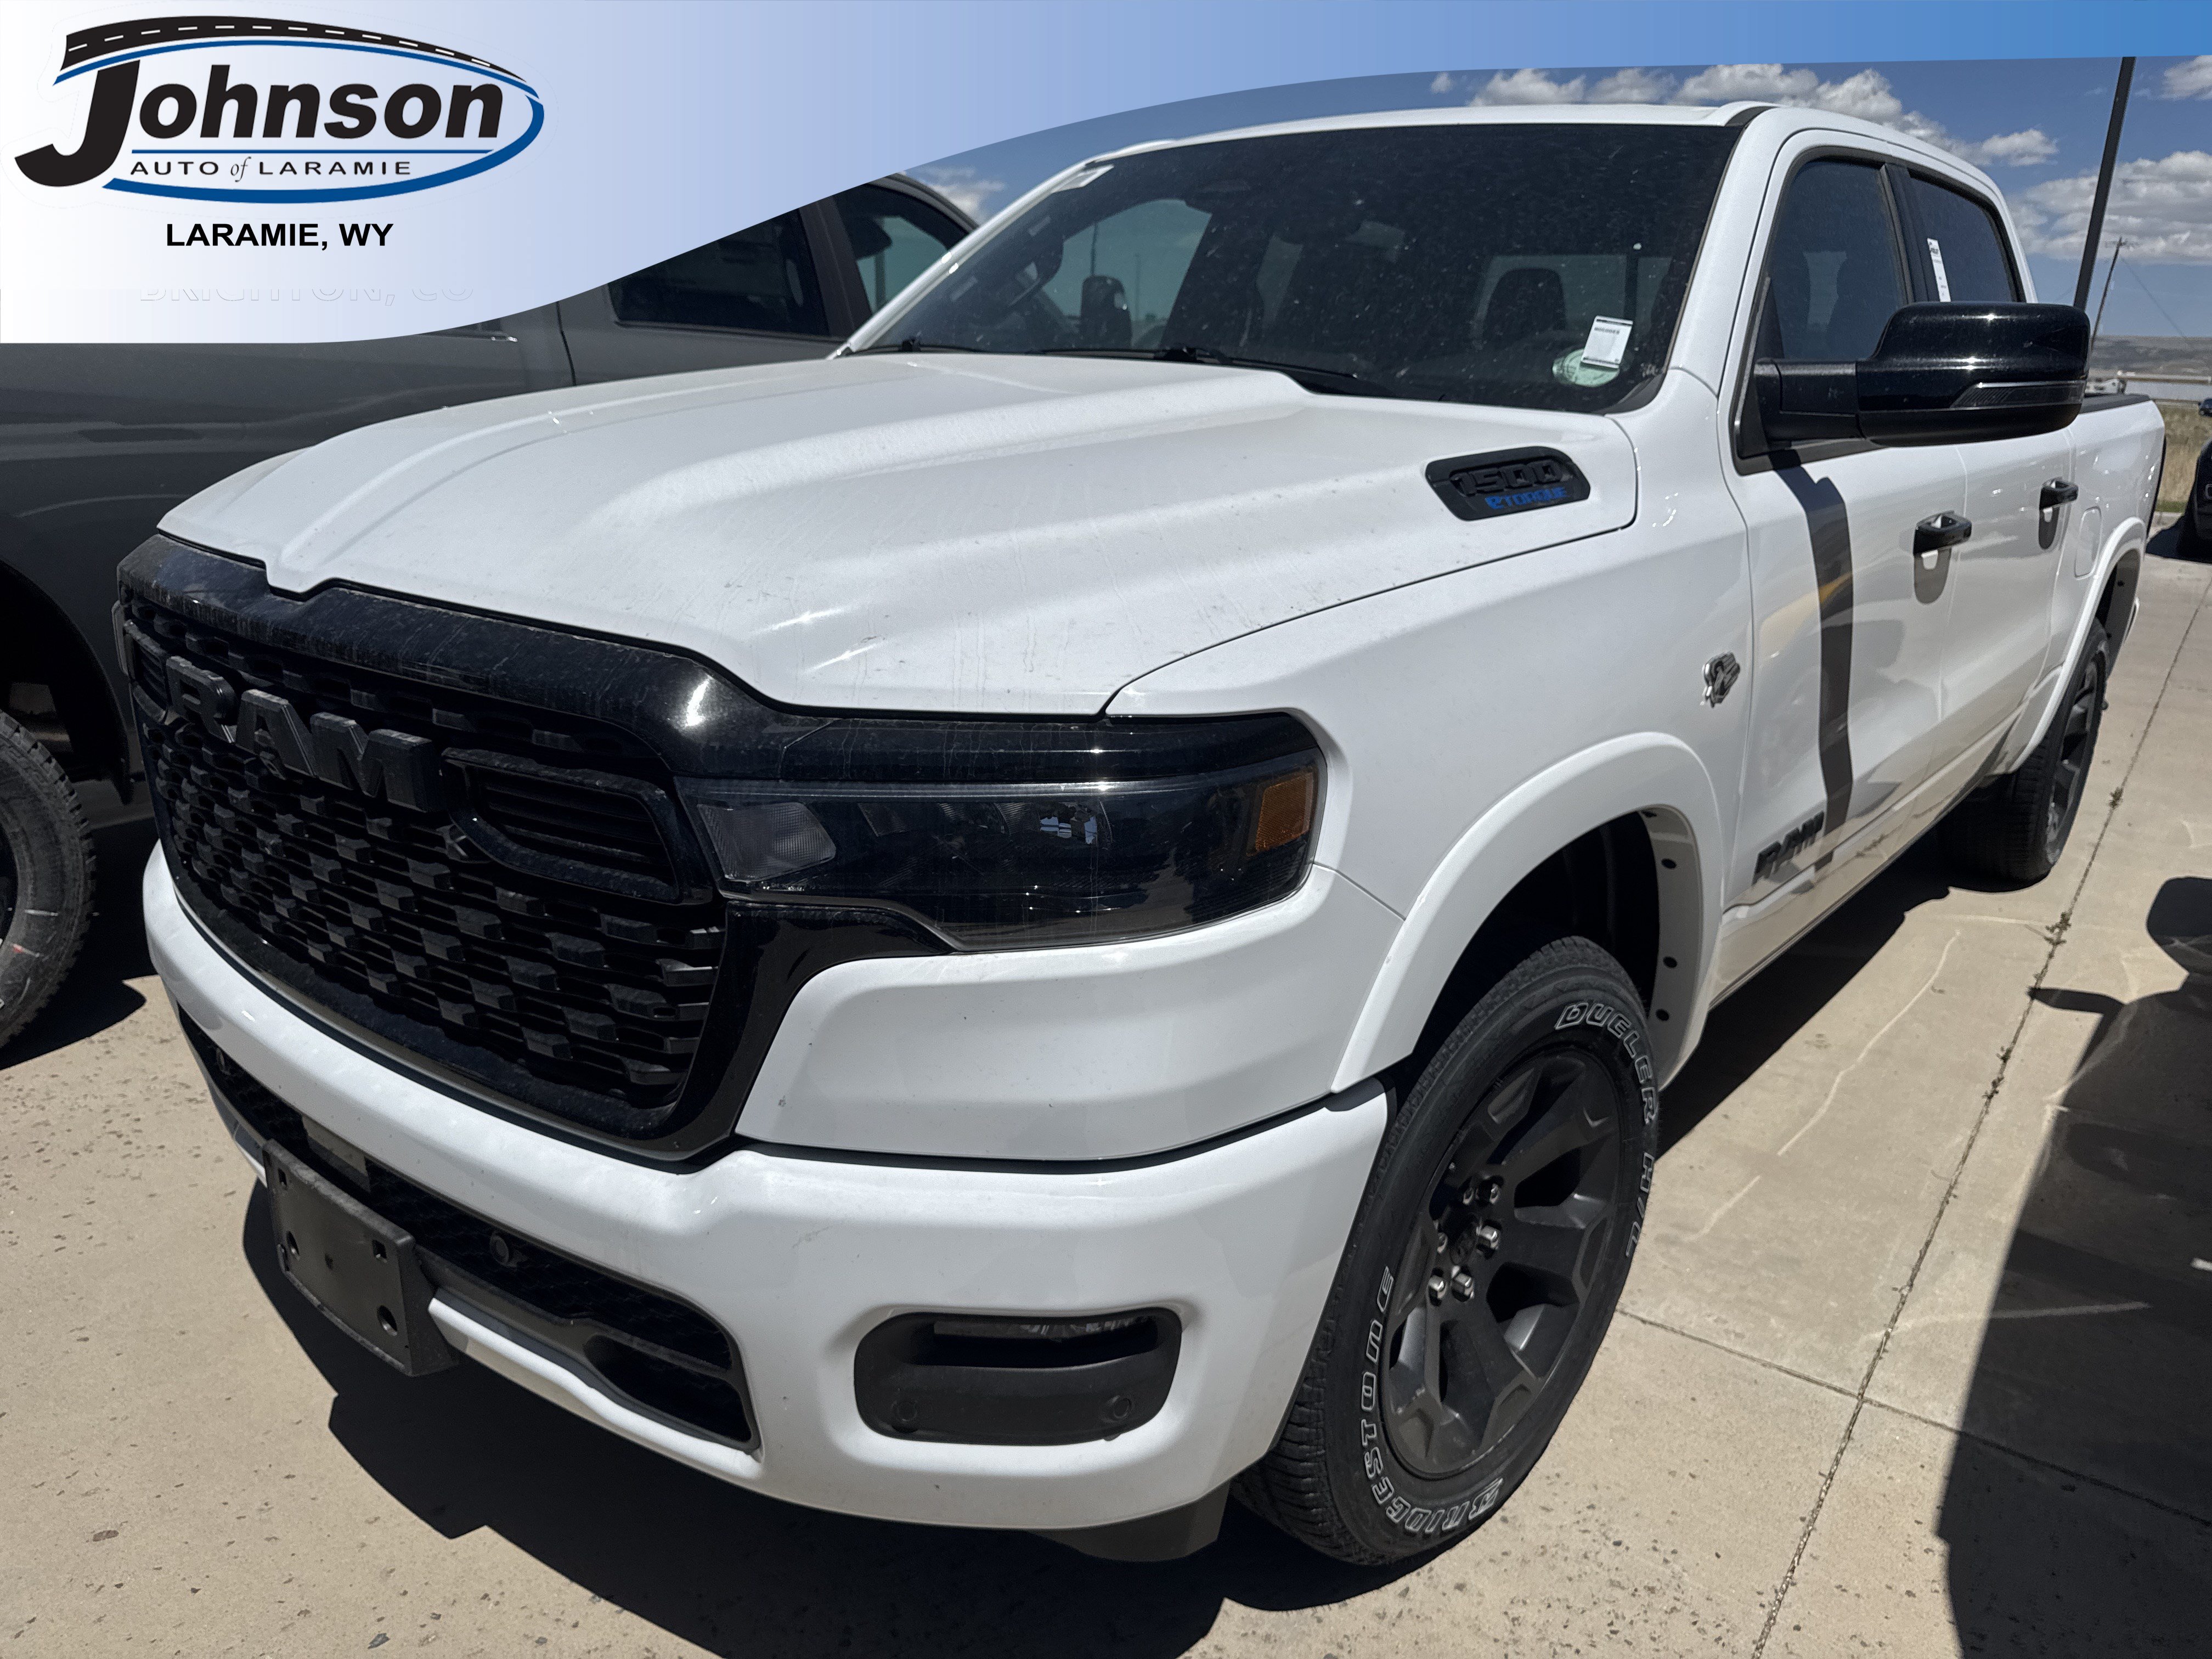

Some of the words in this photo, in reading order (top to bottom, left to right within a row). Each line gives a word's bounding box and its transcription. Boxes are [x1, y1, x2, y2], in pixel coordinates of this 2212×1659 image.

[1449, 459, 1562, 496] 1500
[166, 656, 436, 813] RAM
[1751, 810, 1825, 885] RAM
[1555, 1002, 1659, 1125] DUELER
[1361, 1265, 1504, 1533] BRIDGESTONE
